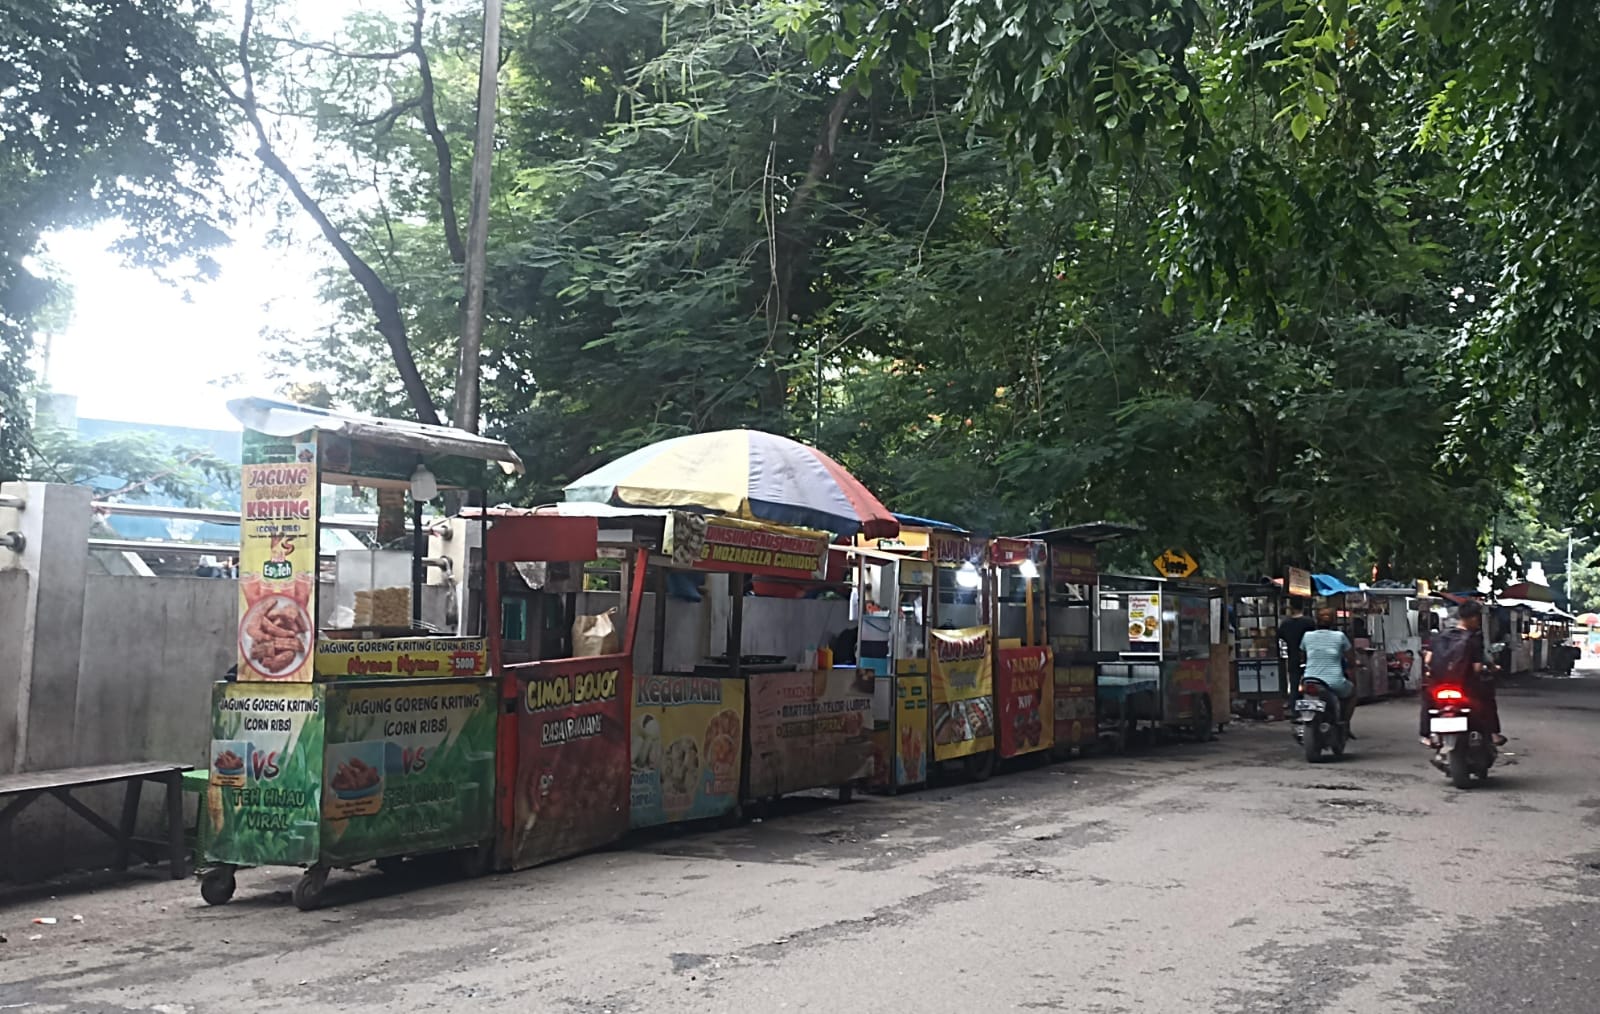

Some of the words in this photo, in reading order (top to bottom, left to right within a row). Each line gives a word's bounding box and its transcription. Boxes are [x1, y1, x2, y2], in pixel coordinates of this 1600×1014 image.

[249, 468, 308, 487] JAGUNG
[246, 500, 310, 520] KRITING
[713, 545, 771, 566] MOZARELLA
[773, 552, 818, 570] CORNDOG
[278, 564, 291, 577] Teh
[319, 641, 355, 654] JAGUNG
[357, 641, 394, 653] GORENG
[396, 640, 431, 652] KRITING
[433, 640, 458, 652] (CORN
[460, 640, 484, 651] RIBS)
[455, 658, 475, 669] 5000
[525, 676, 573, 713] CIMOL
[573, 669, 619, 705] BOJOT
[219, 698, 251, 711] JAGUNG
[252, 699, 286, 712] GORENG
[287, 699, 319, 712] KRITING
[346, 700, 392, 715] JAGUNG
[394, 696, 438, 712] GORENG
[441, 694, 480, 710] KRITING
[244, 717, 269, 731] (CORN
[270, 718, 292, 732] RIBS)
[384, 719, 417, 736] (CORN
[420, 716, 448, 734] RIBS)
[541, 721, 566, 746] RASA
[252, 751, 280, 781] VS
[402, 746, 426, 775] VS
[233, 789, 260, 807] TEH
[265, 788, 305, 808] HIJAU
[247, 812, 288, 831] VIRAL
